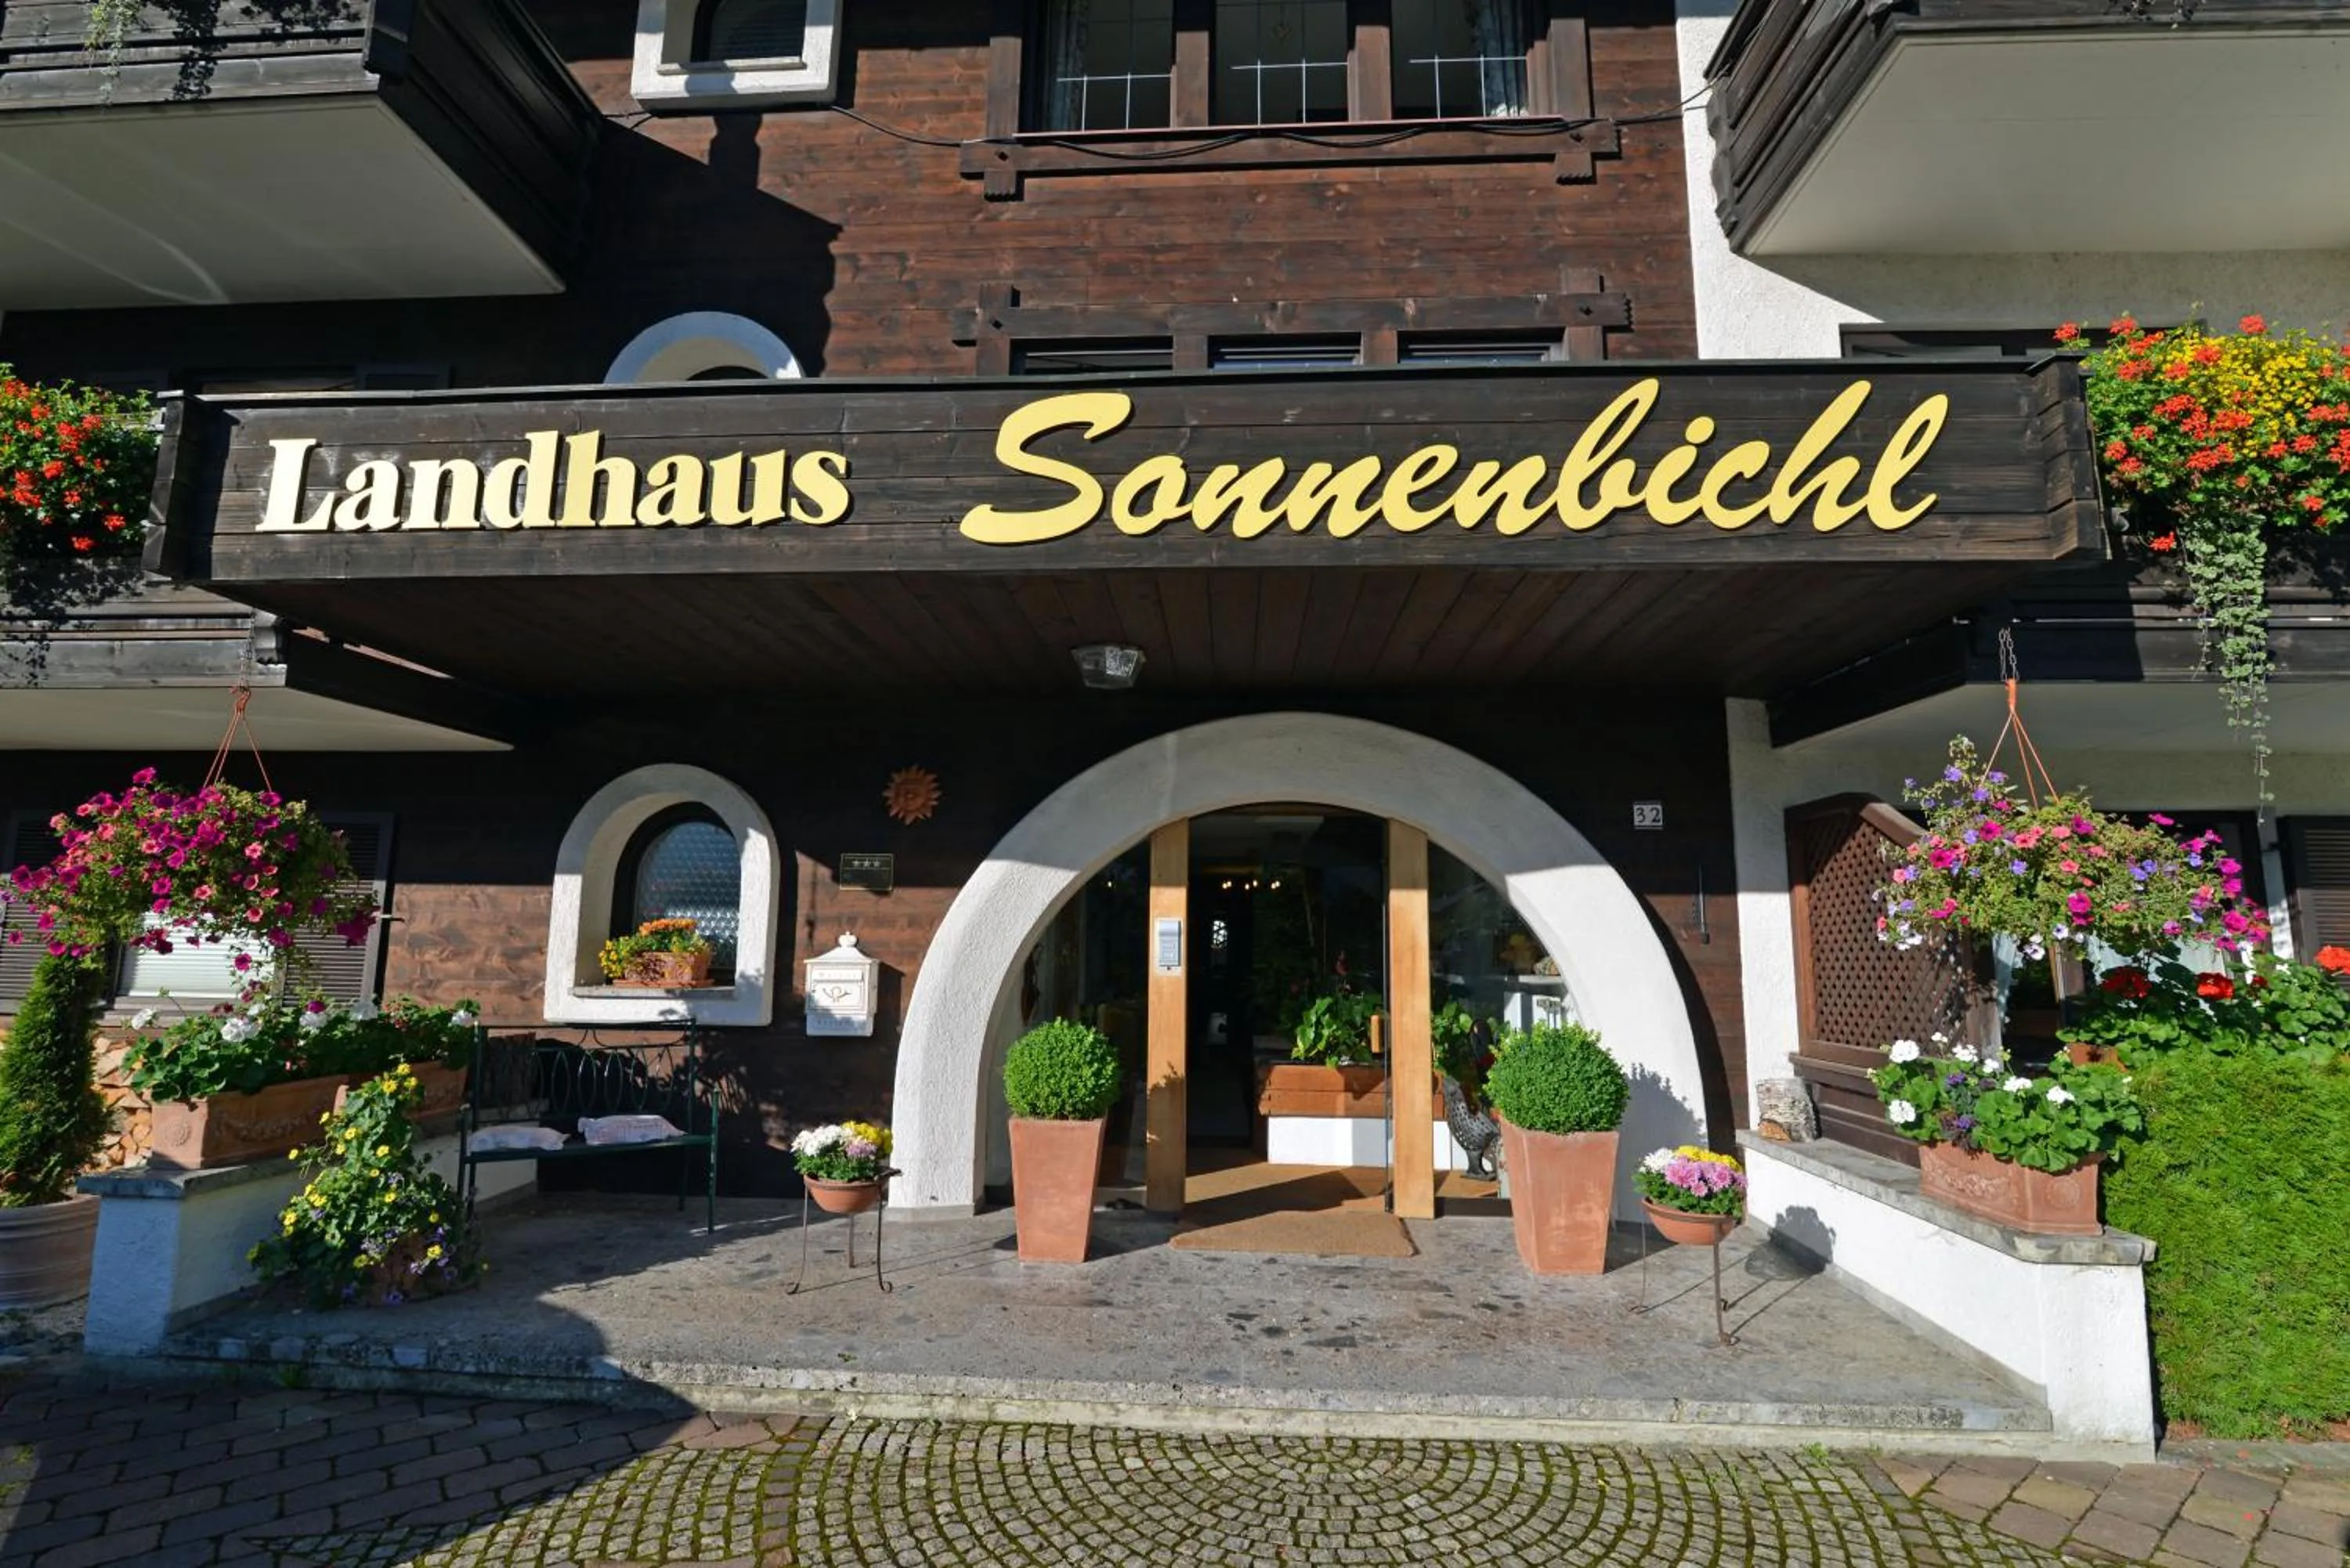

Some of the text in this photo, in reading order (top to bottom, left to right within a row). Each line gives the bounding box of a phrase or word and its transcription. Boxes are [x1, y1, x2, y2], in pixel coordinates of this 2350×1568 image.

[255, 378, 1949, 544] Landhaus Sonnenbichl
[1636, 807, 1661, 823] 32
